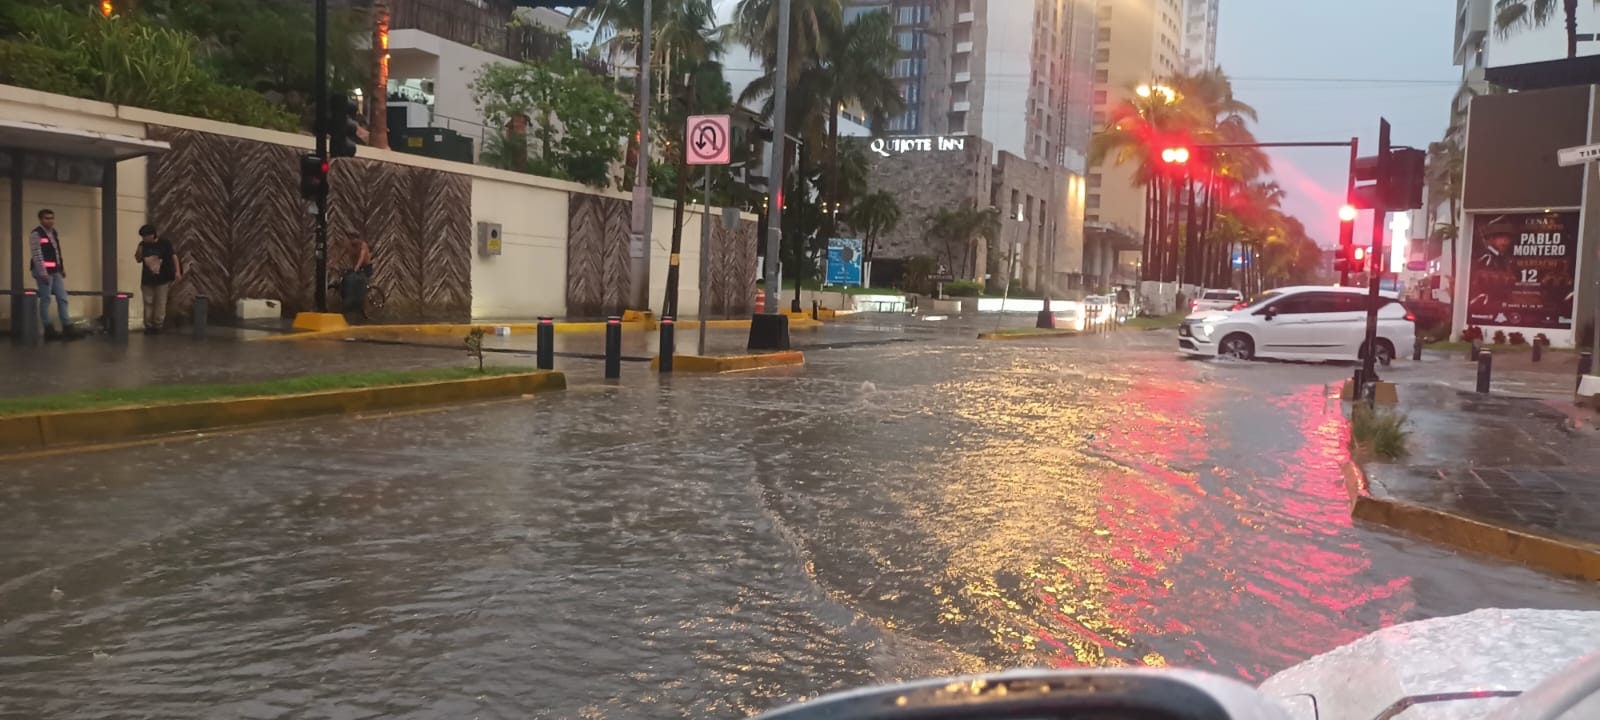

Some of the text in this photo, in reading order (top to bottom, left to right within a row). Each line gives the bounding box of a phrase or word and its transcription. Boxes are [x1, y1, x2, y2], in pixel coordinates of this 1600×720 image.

[938, 136, 965, 151] INN
[1520, 232, 1561, 245] PABLO
[1513, 245, 1566, 256] MONTERO
[1521, 269, 1538, 283] 12
